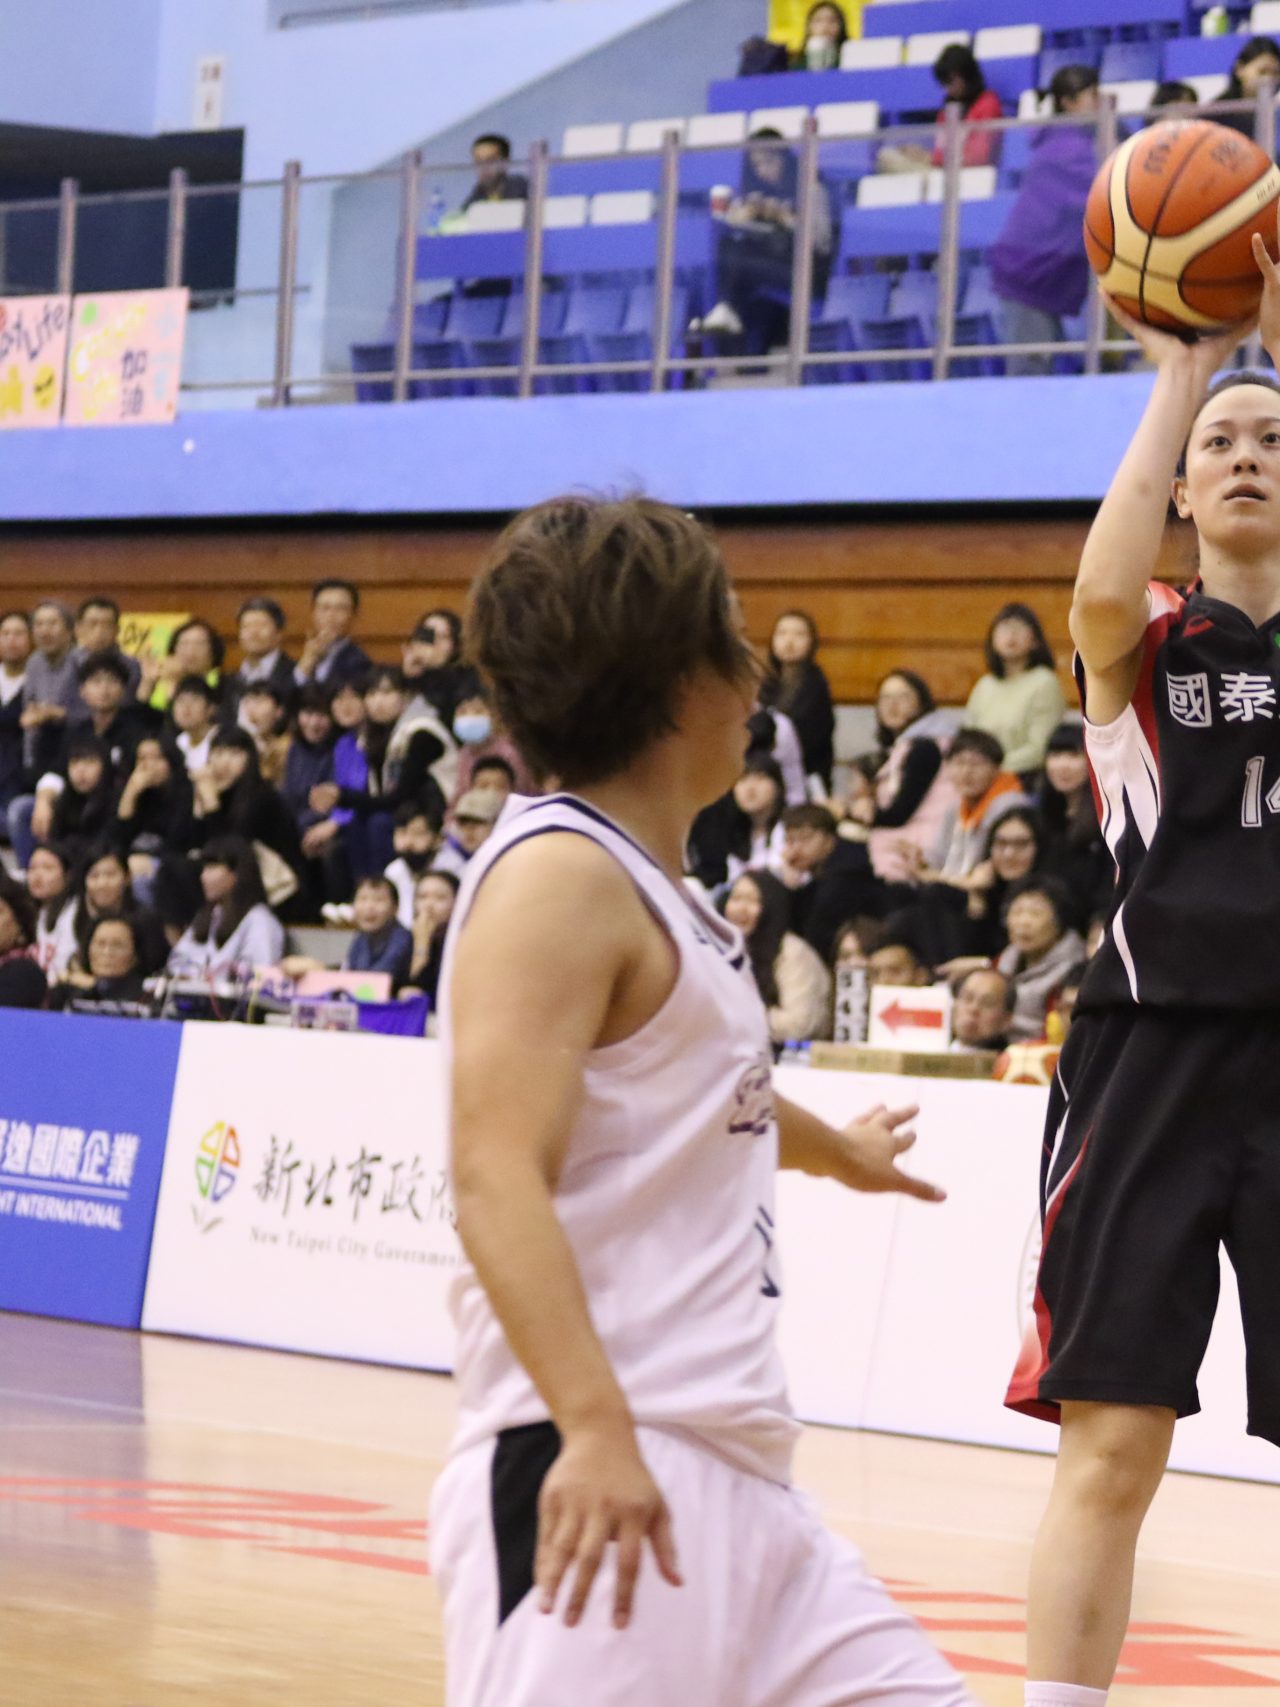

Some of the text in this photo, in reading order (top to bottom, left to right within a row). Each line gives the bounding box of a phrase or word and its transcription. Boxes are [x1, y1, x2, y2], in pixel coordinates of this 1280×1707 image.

[15, 1193, 122, 1231] INTERNATIONAL
[251, 1226, 279, 1245] New
[287, 1229, 332, 1255] Taipei
[337, 1235, 370, 1259] City
